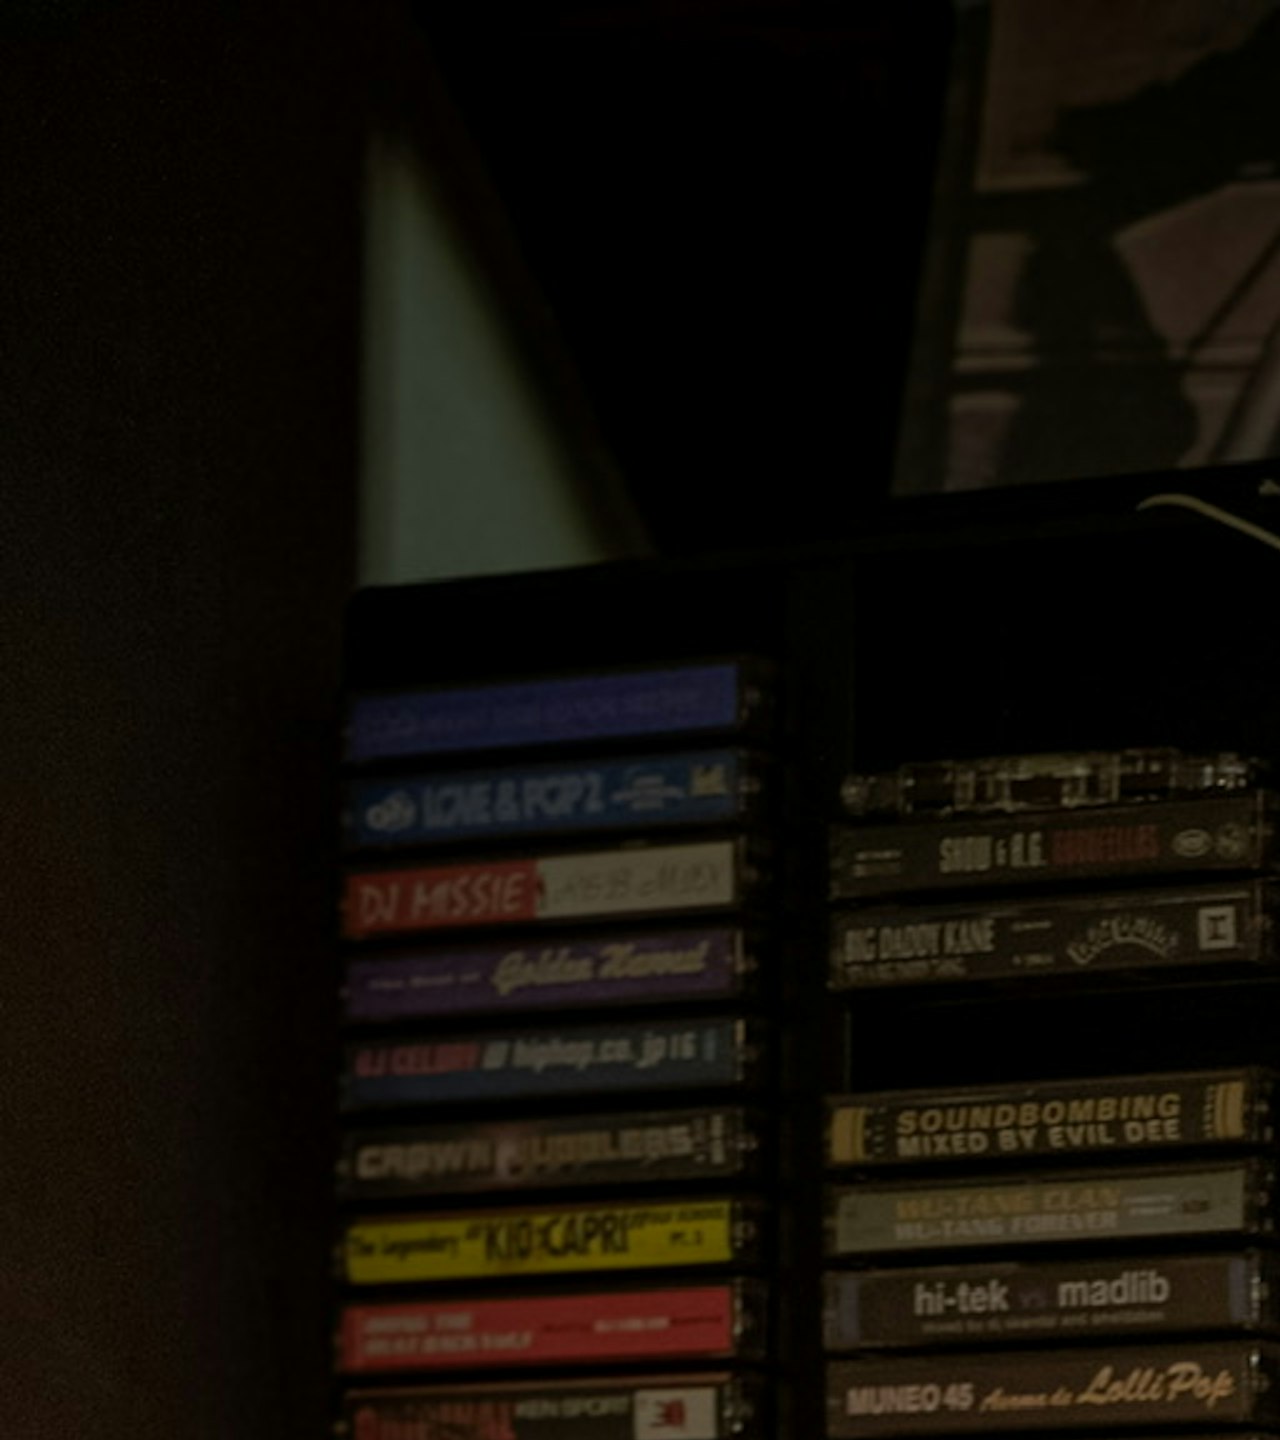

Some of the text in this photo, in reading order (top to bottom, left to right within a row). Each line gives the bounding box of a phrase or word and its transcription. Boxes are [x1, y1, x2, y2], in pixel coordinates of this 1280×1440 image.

[895, 1092, 1183, 1135] SOUNDBOMBING
[895, 1118, 1182, 1158] MIXED BY EVIL DEE
[912, 1268, 1172, 1317] hi-tek madlib
